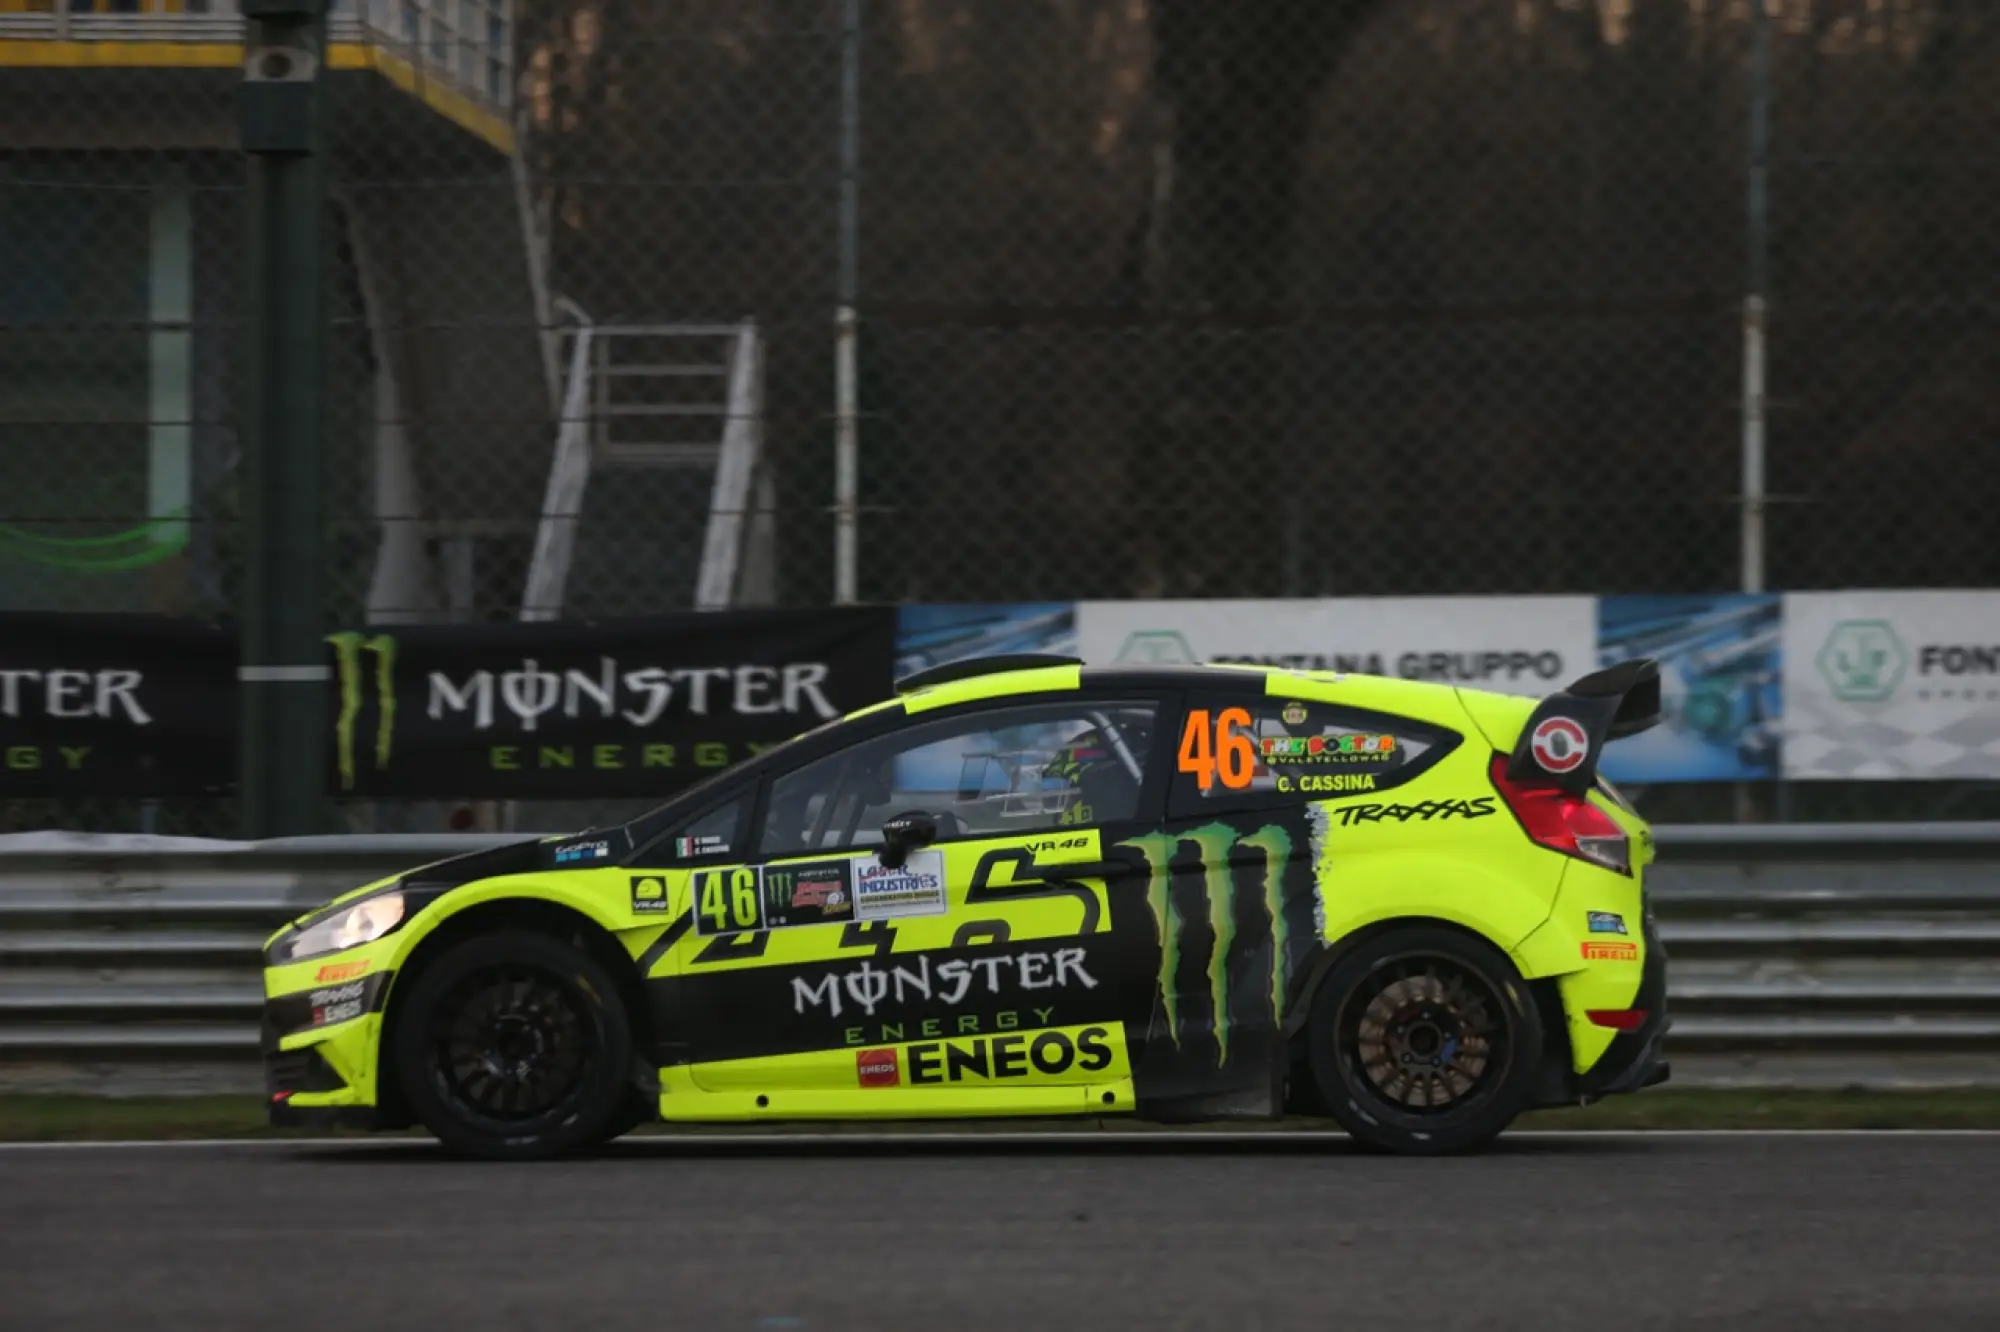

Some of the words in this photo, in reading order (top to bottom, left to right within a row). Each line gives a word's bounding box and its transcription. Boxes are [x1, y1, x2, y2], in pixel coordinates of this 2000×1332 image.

[1396, 651, 1564, 681] GRUPPO
[427, 656, 838, 732] MONSTER
[1178, 706, 1254, 790] 46
[1261, 736, 1306, 756] THE
[1308, 733, 1396, 756] DOCTOR
[1299, 773, 1376, 792] CASSINA
[1333, 797, 1496, 827] TRAXXAS
[701, 868, 757, 930] 46
[1580, 941, 1638, 961] PIRELLI
[790, 946, 1099, 1018] MONSTER
[844, 1006, 1055, 1045] ENERGY
[907, 1027, 1113, 1085] ENEOS
